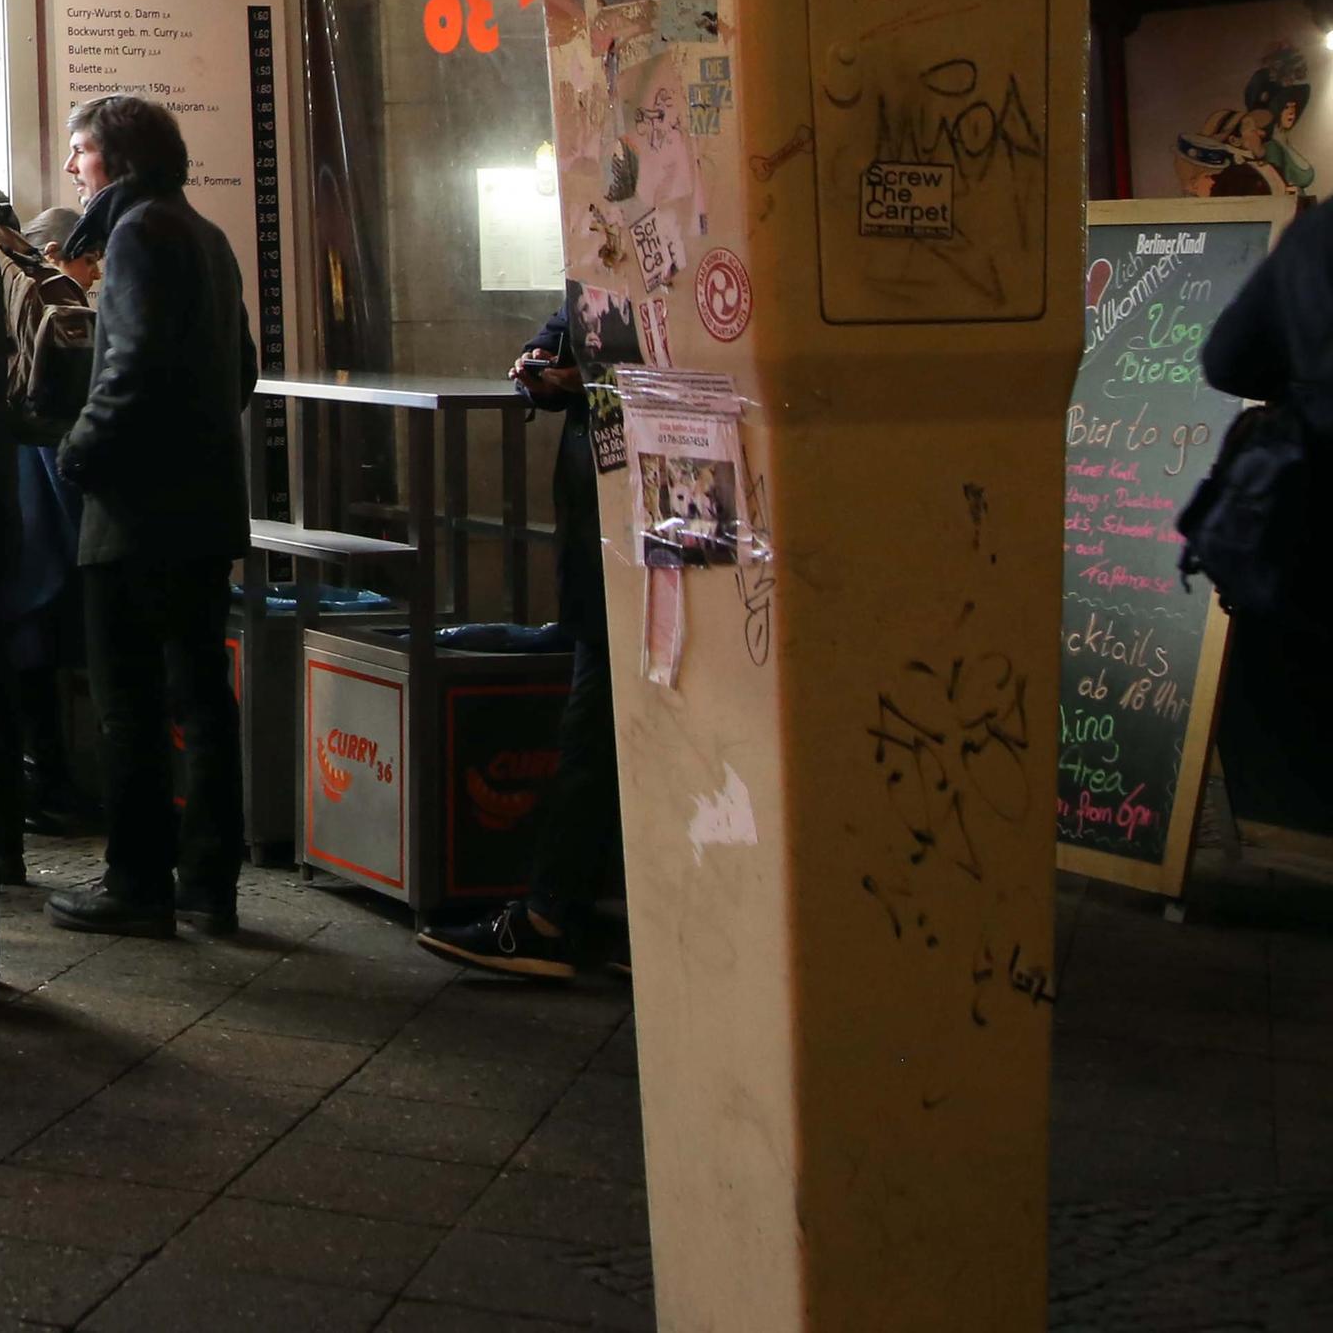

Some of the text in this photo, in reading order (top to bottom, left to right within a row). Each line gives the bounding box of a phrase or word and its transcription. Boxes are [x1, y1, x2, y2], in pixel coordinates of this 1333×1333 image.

[67, 8, 121, 19] Curry-Wurst
[135, 9, 161, 18] Darm
[67, 27, 115, 37] Bockwurst
[153, 28, 179, 40] Curry
[68, 45, 102, 55] Bulette
[104, 45, 120, 55] mit
[122, 46, 147, 58] Curry
[69, 64, 103, 74] Bulette
[149, 83, 171, 95] 150g
[167, 102, 205, 113] Majoran
[204, 176, 242, 186] Pommes
[866, 165, 943, 187] Screw
[867, 184, 913, 203] The
[866, 199, 949, 225] Carpet
[1136, 232, 1206, 254] Berliner Kindl
[1179, 273, 1212, 301] im
[1066, 402, 1210, 475] Bier to go
[1066, 612, 1169, 677] cktails
[1077, 667, 1109, 700] ab
[1119, 678, 1153, 711] 18
[328, 728, 393, 784] CURRY 36
